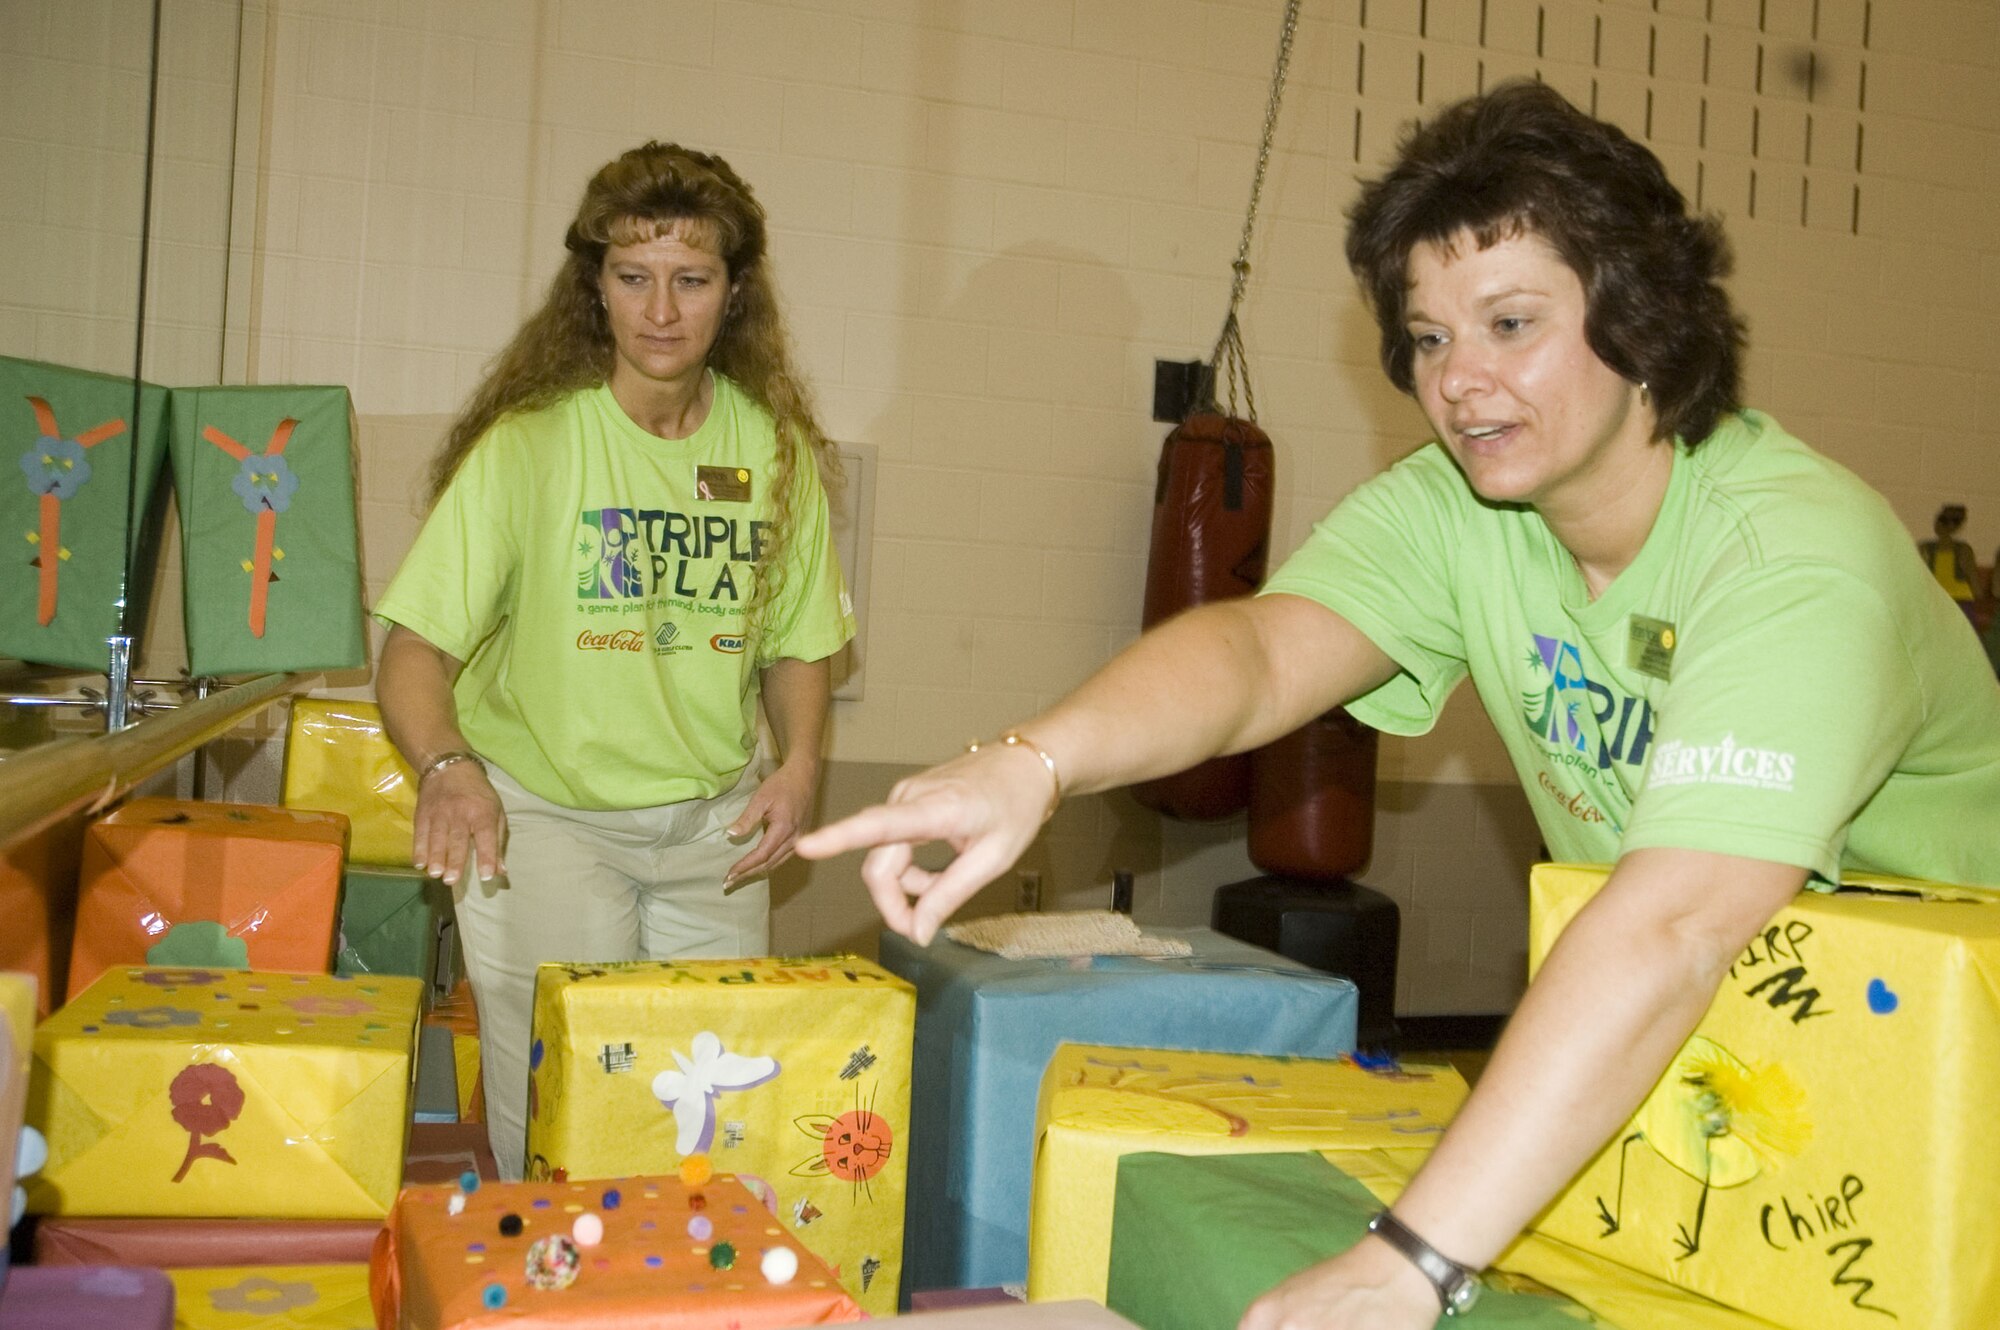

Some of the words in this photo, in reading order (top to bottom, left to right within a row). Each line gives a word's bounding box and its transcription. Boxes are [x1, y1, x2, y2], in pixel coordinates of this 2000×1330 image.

[638, 509, 773, 563] TRIPLE
[577, 604, 584, 613] a
[588, 604, 619, 615] game
[623, 601, 645, 616] plan
[668, 599, 695, 614] mind,
[698, 603, 726, 617] body
[577, 629, 645, 653] Coca-Cola
[719, 638, 745, 650] KRA
[1652, 731, 1796, 783] SERVICES
